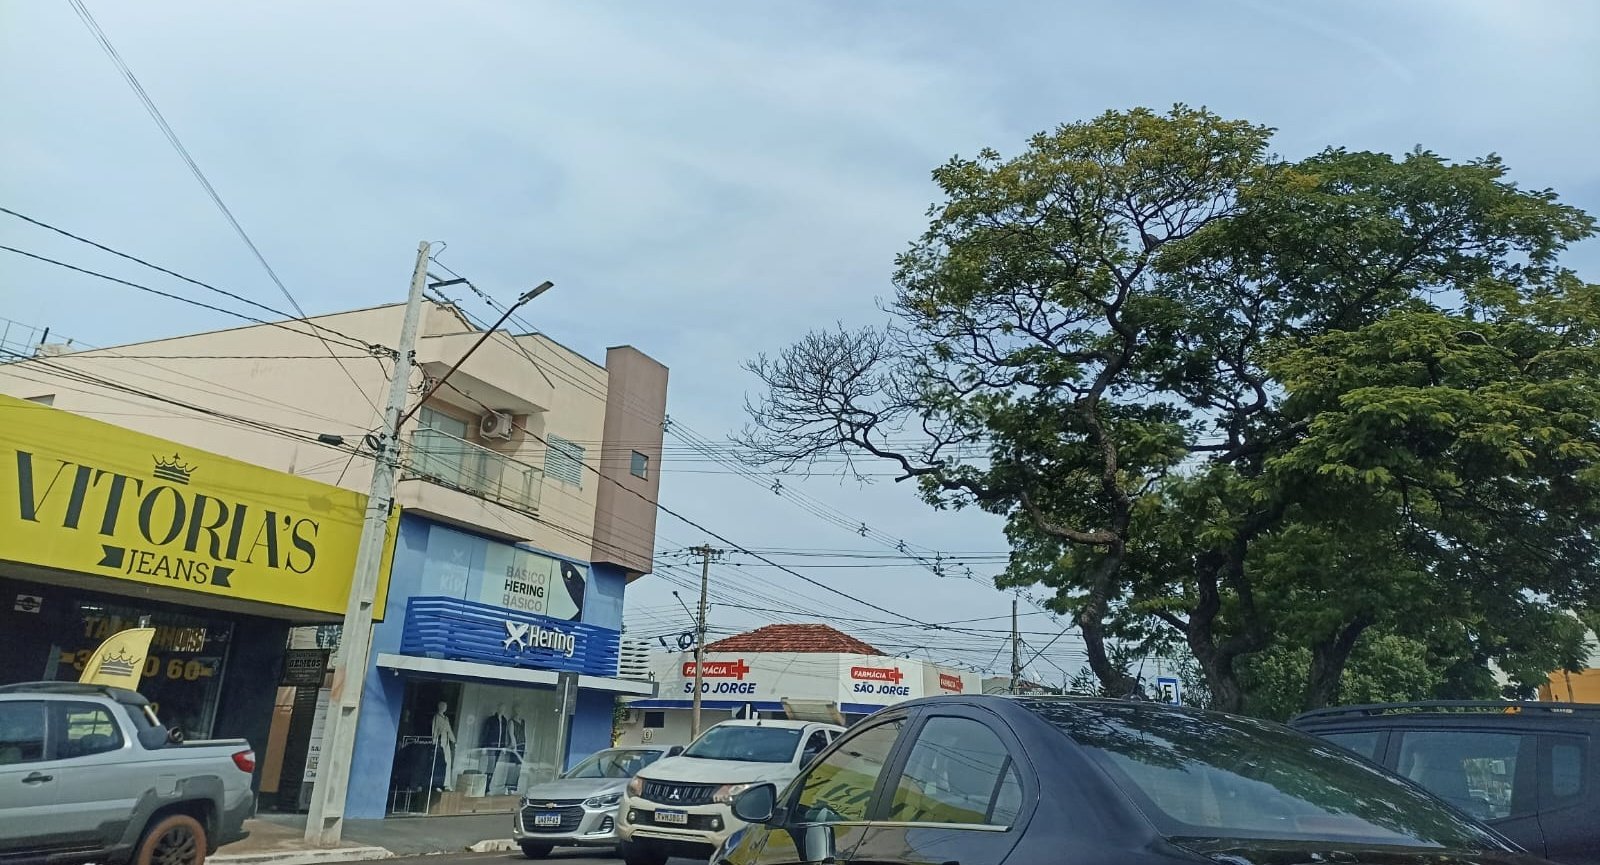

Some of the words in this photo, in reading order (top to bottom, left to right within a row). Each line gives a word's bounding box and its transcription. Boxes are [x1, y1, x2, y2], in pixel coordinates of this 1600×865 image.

[15, 449, 319, 574] VITORIA'S
[126, 549, 210, 584] JEANS
[506, 565, 546, 585] BASICO
[504, 579, 544, 598] HERING
[502, 594, 543, 612] BASICO
[529, 625, 576, 658] Hering
[686, 666, 727, 675] FAMÁCIA
[853, 670, 887, 679] FARMÁCIA
[712, 682, 756, 694] JORGE
[876, 685, 909, 696] JORGE
